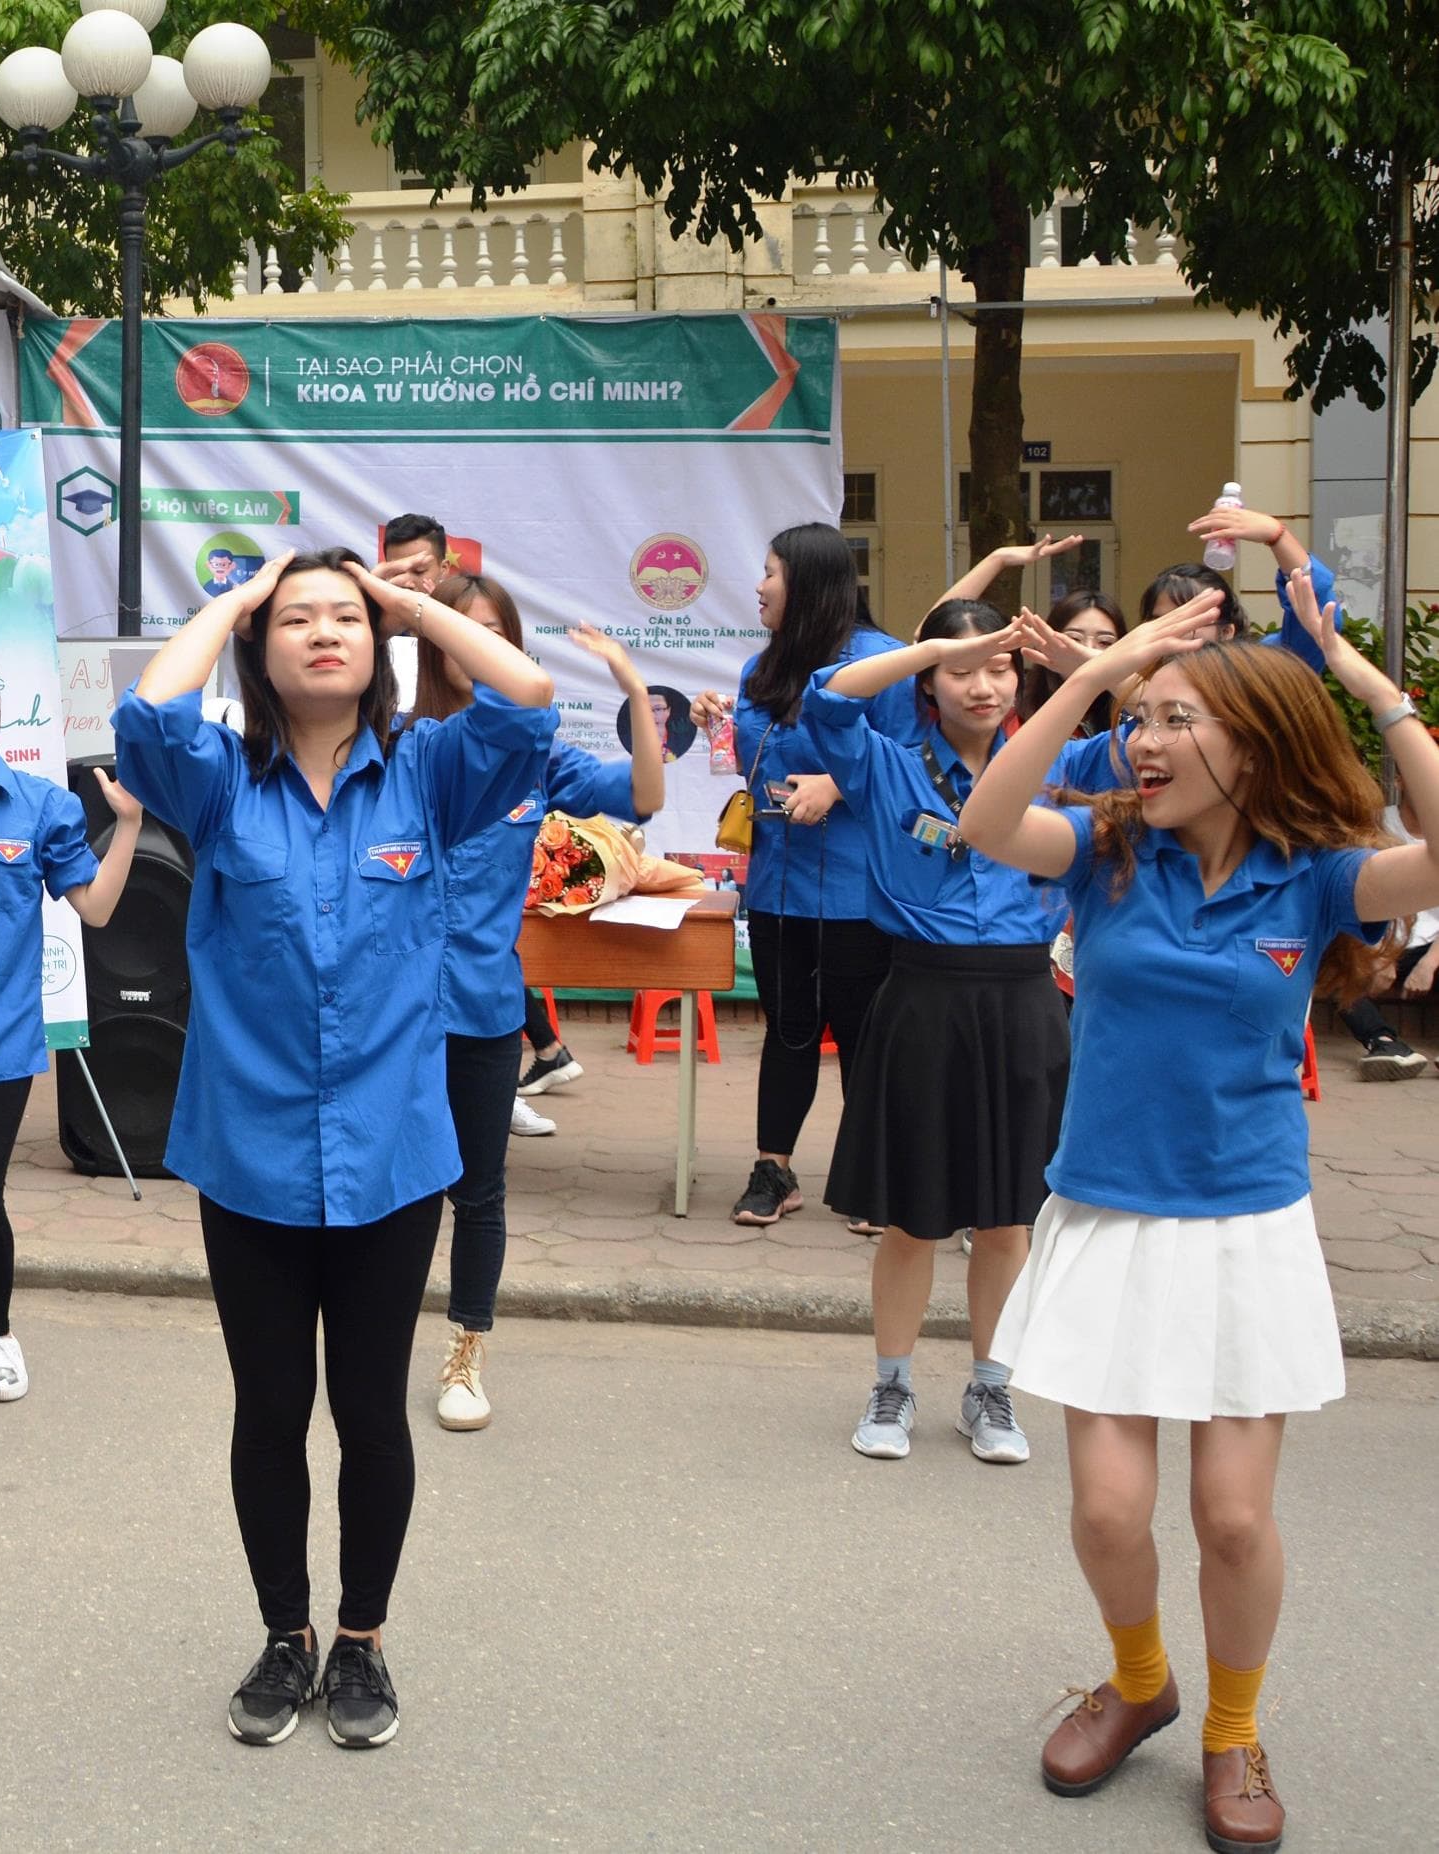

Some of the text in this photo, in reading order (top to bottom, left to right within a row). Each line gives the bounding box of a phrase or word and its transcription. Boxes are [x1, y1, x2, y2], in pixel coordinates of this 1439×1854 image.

[296, 350, 523, 381] TẠI SAO PHẢI CHỌN
[297, 373, 683, 403] KHOA TƯ TƯỞNG HỒ CHÍ MINH?
[1027, 447, 1048, 457] 102
[157, 498, 187, 517] HỘI
[192, 498, 230, 519] VIỆC
[234, 498, 269, 516] LÀM
[142, 615, 166, 625] CÁC
[648, 614, 692, 627] CÁN BỘ
[535, 624, 570, 635] NGHIÊ
[616, 625, 641, 637] CÁC
[675, 628, 711, 638] TRUNG
[714, 627, 736, 638] TÂM
[739, 629, 772, 638] NGHI
[644, 636, 659, 648] HỒ
[664, 638, 683, 649] CHÍ
[687, 640, 715, 649] MINH
[568, 702, 592, 711] NAM
[5, 748, 41, 763] SINH
